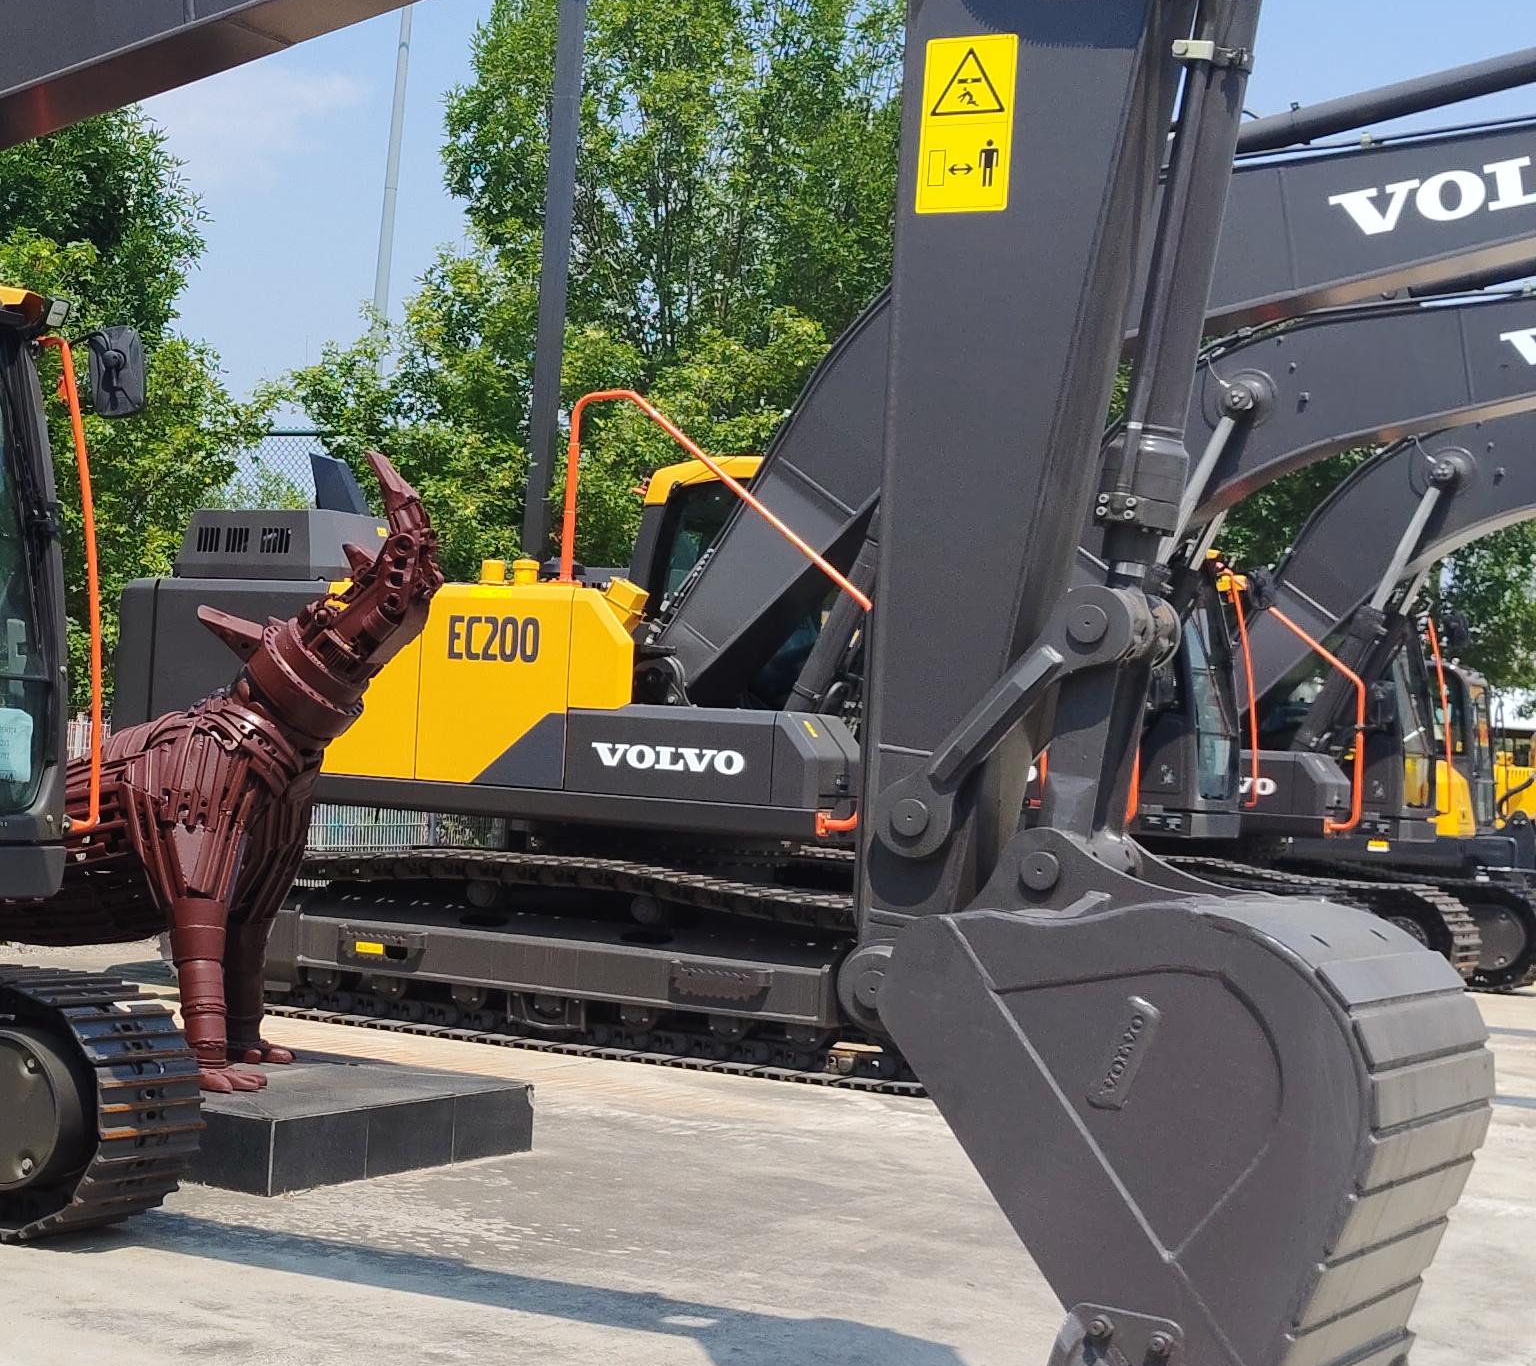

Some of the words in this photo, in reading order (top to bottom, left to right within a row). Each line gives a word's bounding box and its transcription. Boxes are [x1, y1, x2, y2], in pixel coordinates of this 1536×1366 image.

[448, 615, 540, 663] EC200
[591, 742, 745, 776] VOLVO
[1102, 1014, 1145, 1093] VOLVO
